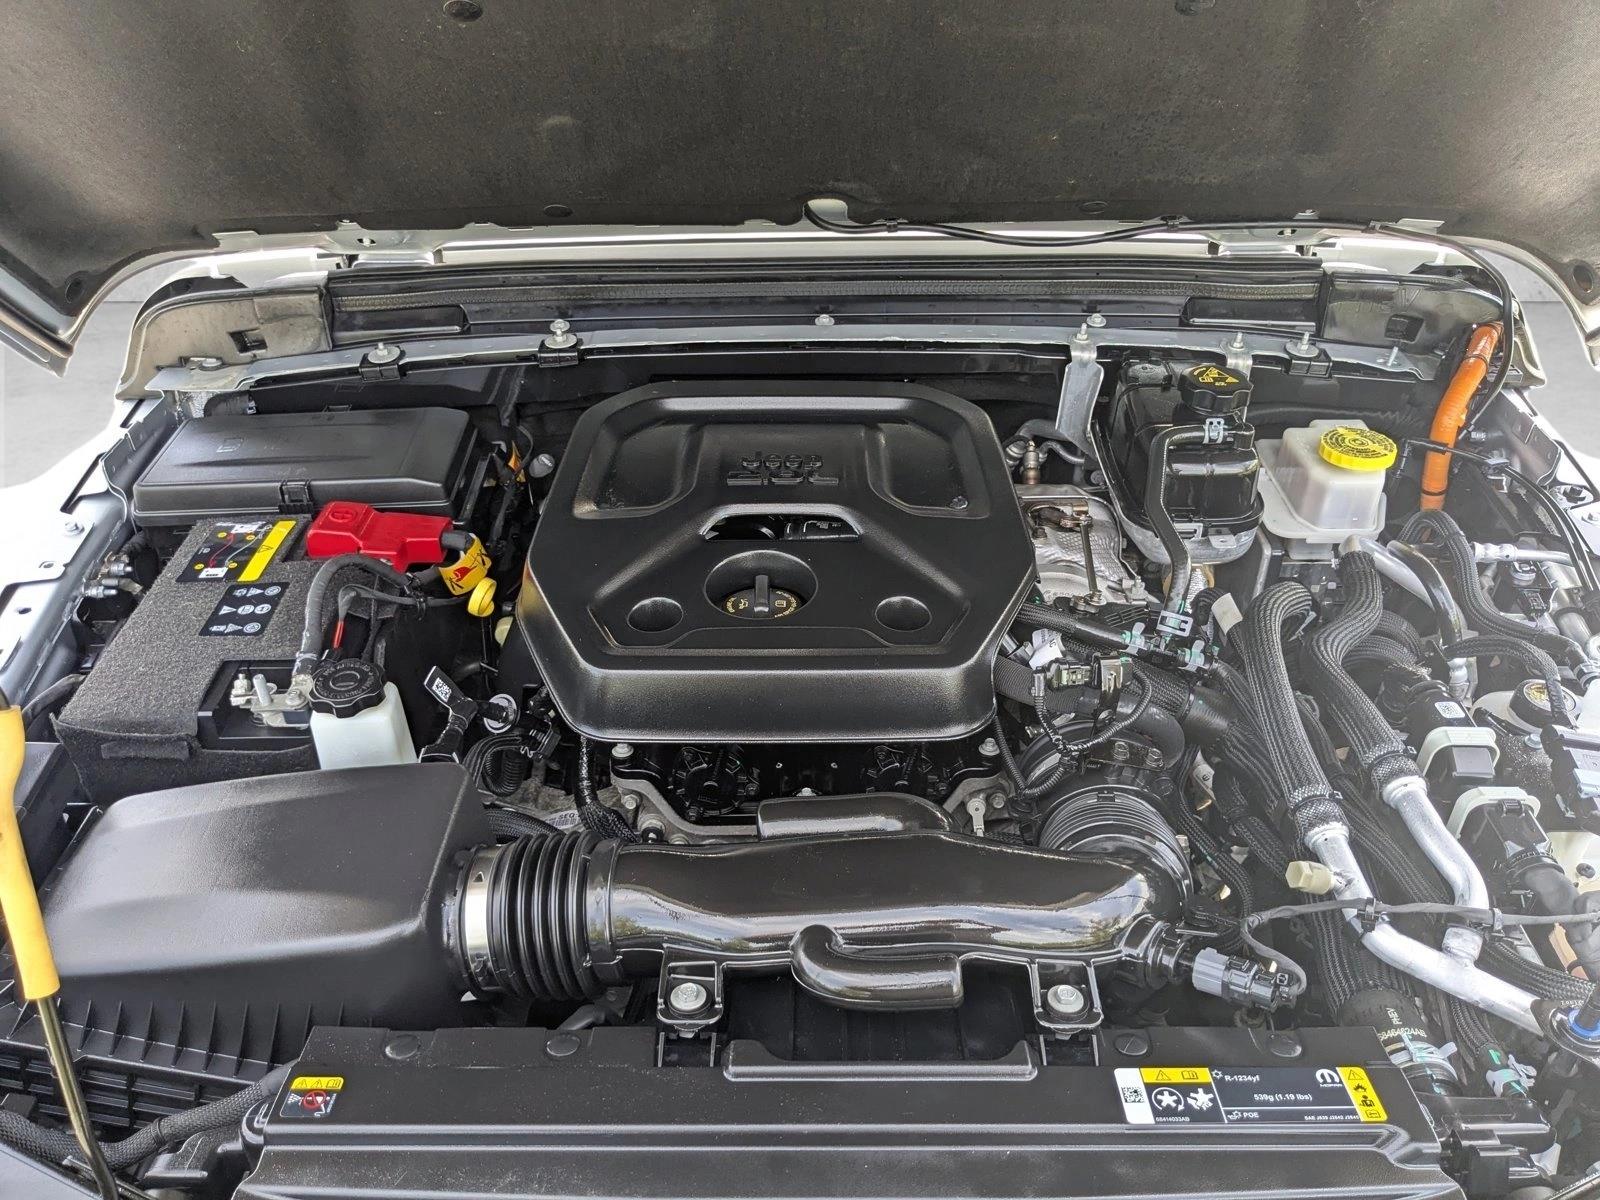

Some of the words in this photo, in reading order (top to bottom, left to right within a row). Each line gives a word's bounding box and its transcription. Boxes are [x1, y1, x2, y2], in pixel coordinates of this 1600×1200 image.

[741, 451, 823, 470] Jeep
[1253, 1093, 1275, 1101] 539g
[1275, 1093, 1295, 1101] (1.19
[1295, 1093, 1313, 1102] lbs)
